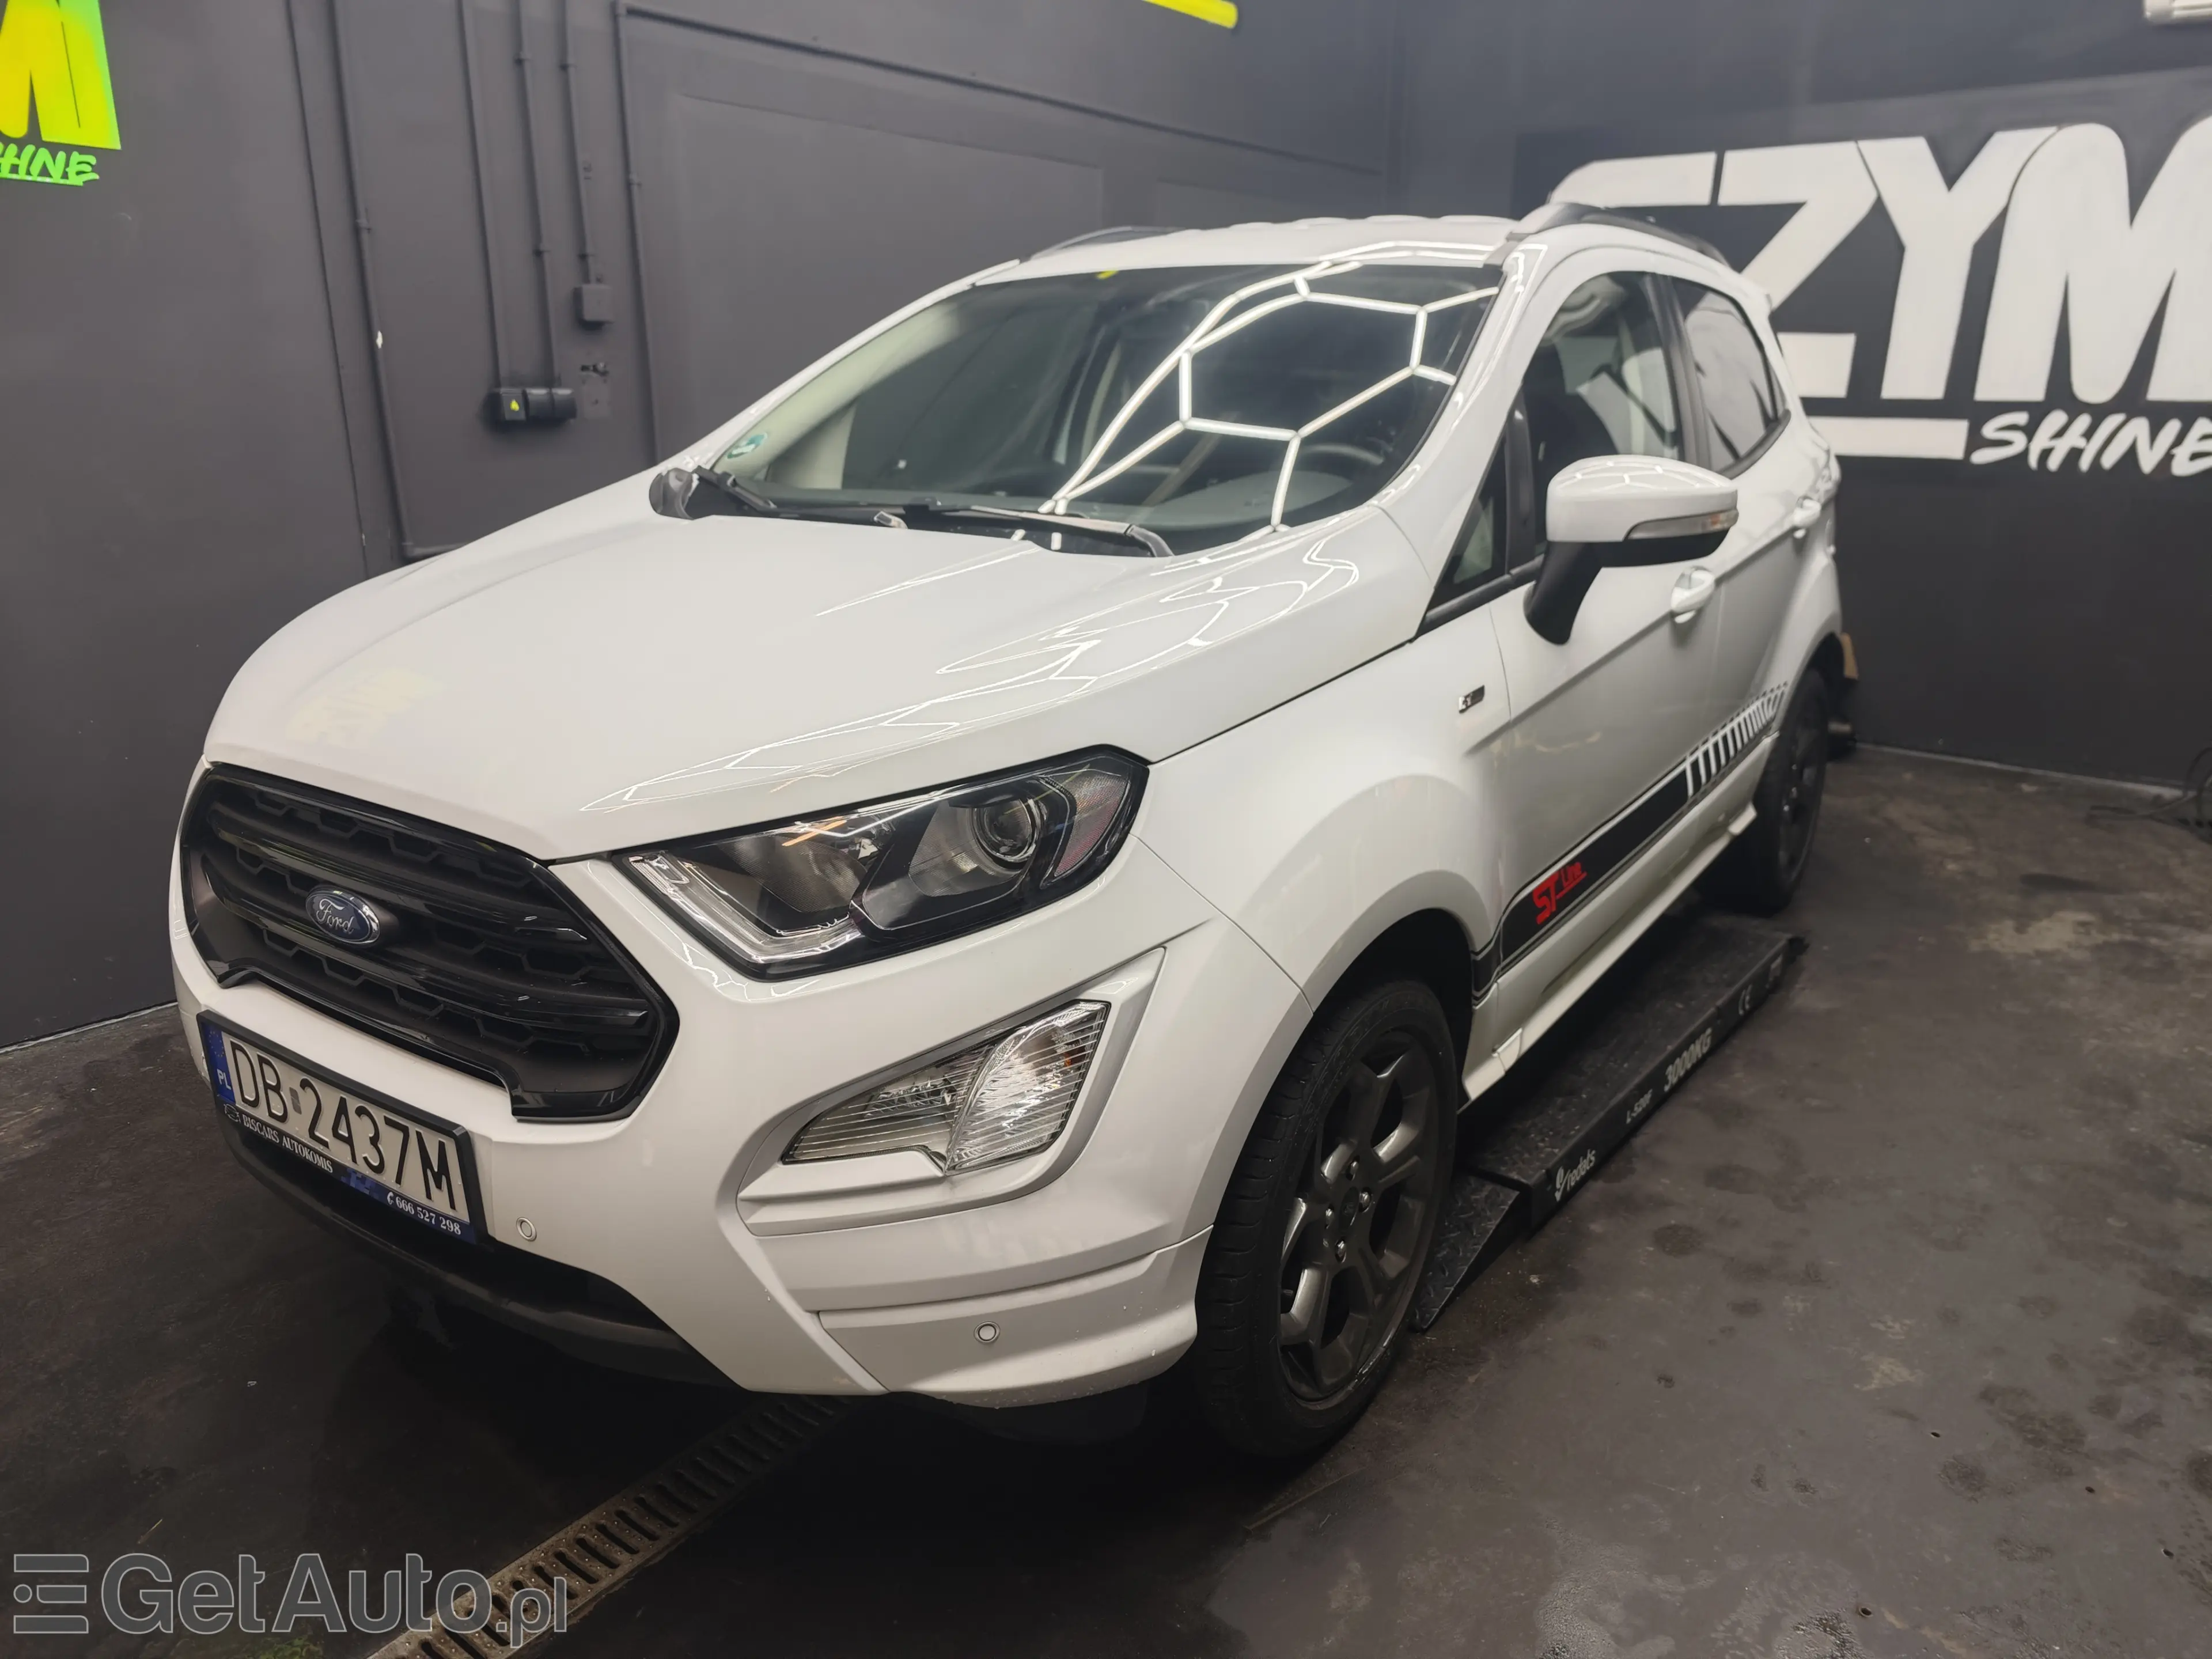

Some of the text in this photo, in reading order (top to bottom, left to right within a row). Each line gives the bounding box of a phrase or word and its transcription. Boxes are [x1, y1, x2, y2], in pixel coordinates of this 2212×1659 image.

[1969, 409, 2212, 476] SHINE
[316, 898, 355, 934] Ford
[217, 1069, 231, 1090] PL
[230, 1039, 456, 1210] DB 2437M
[243, 1113, 333, 1173] BISCARS AUTOKOMIS
[396, 1196, 461, 1236] 666 527 298
